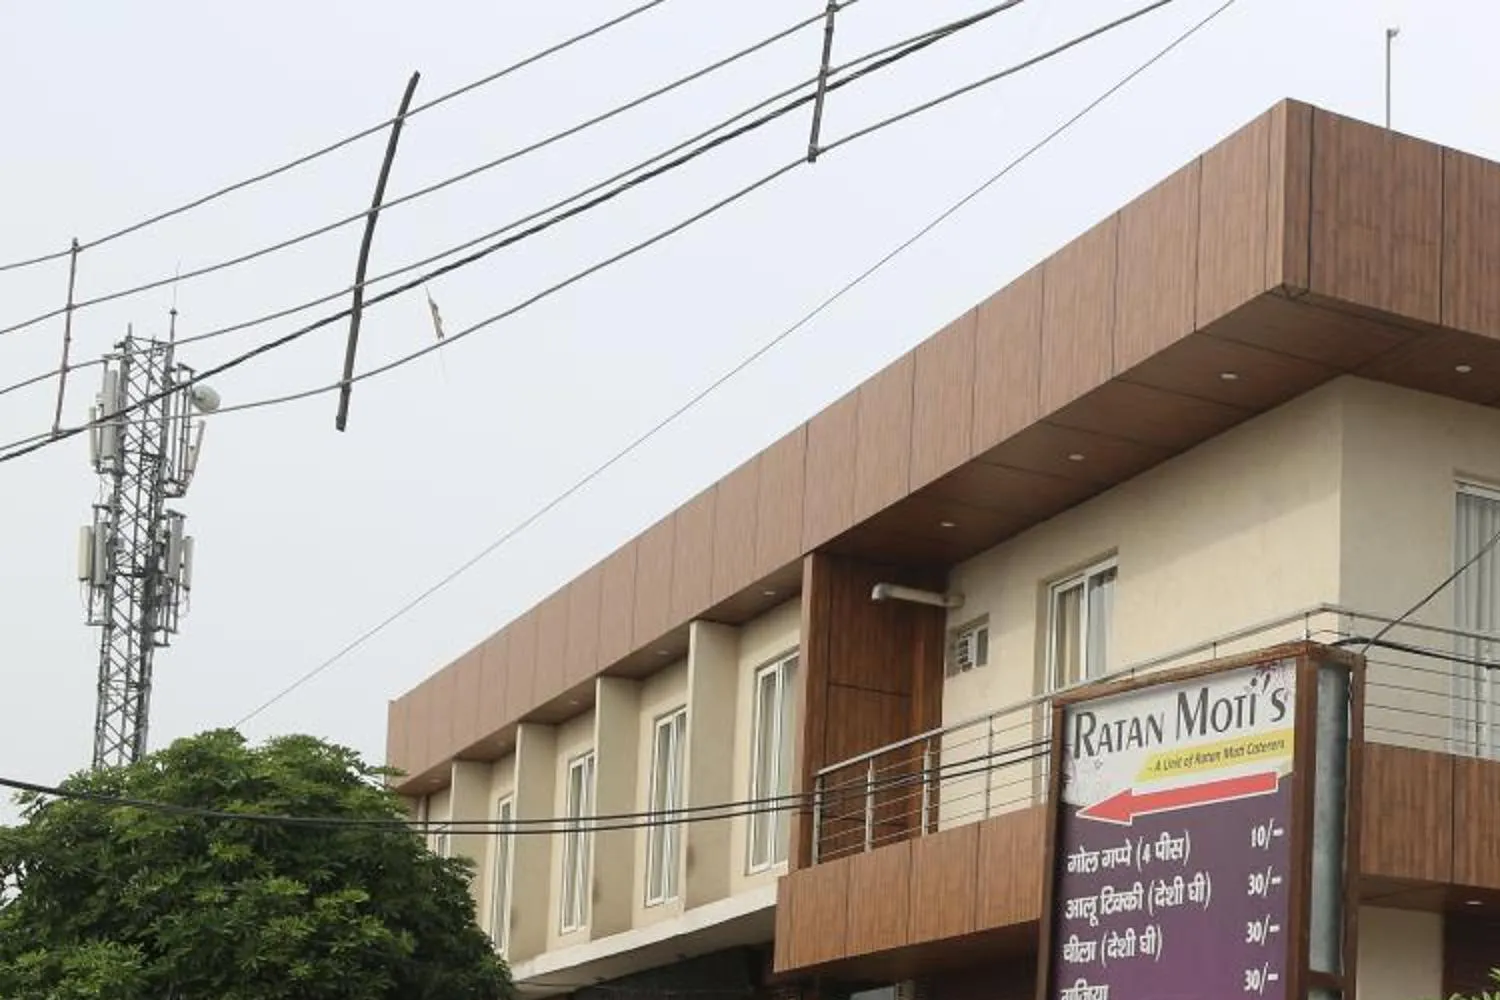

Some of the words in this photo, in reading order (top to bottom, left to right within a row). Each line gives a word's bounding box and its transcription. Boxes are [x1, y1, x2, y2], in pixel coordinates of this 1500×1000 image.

[1067, 845, 1099, 874] गोल
[1155, 829, 1191, 867] पीस)
[1251, 818, 1283, 851] 10/-
[1066, 895, 1098, 925] आलू
[1100, 880, 1142, 915] टिक्की
[1148, 875, 1183, 916] (देशी
[1188, 871, 1211, 910] घी)
[1247, 865, 1282, 898] 30/-
[1101, 927, 1136, 967] (देशी
[1140, 924, 1163, 961] घी)
[1246, 914, 1281, 947] 30/-
[1244, 961, 1278, 995] 30/-
